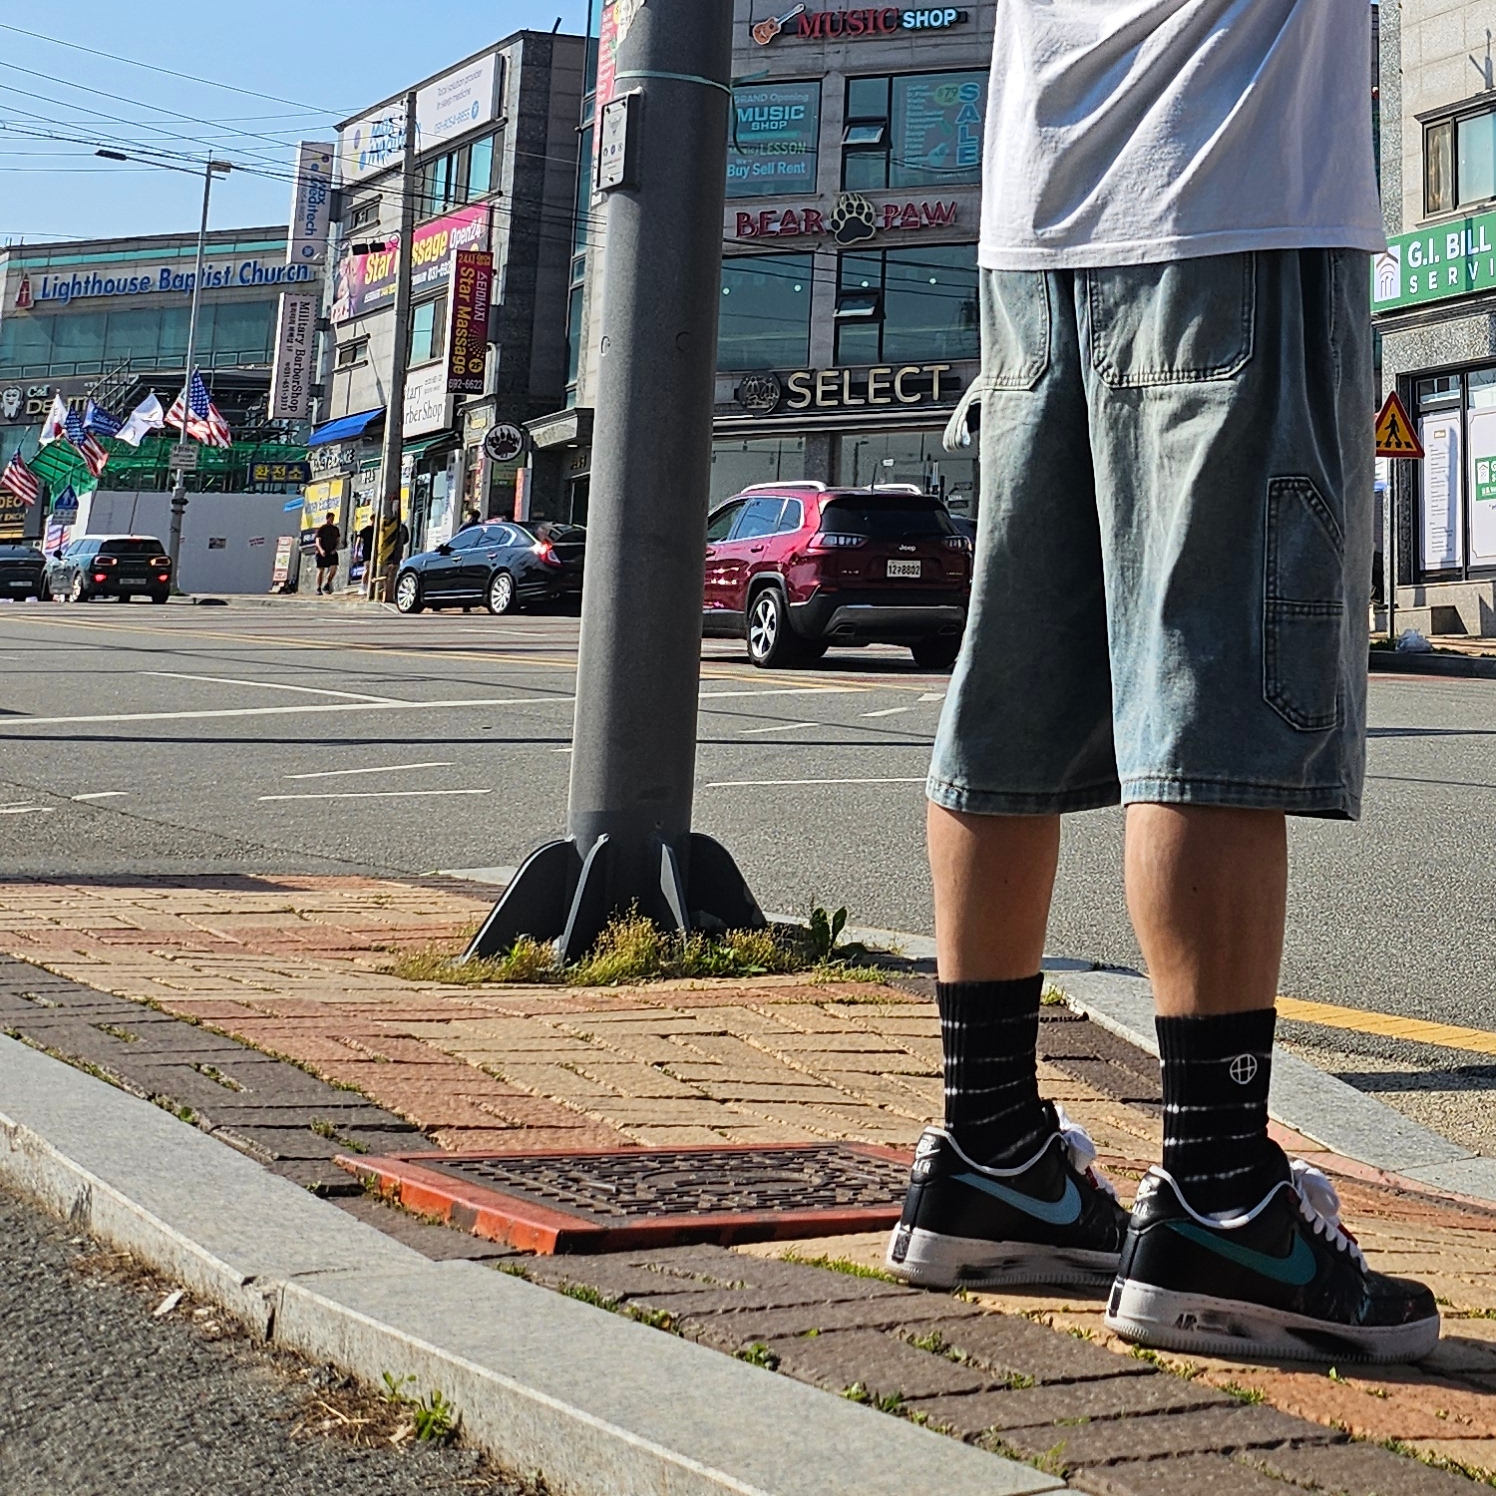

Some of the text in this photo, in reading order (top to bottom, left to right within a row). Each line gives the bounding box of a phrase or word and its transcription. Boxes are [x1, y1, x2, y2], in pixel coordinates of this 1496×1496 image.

[796, 7, 958, 38] MUSIC SHOP
[737, 105, 805, 122] MUSIC
[751, 120, 788, 131] SHOP
[955, 82, 981, 166] SALE
[760, 141, 806, 156] LESSON
[727, 161, 806, 179] Buy Sell Rent
[736, 201, 958, 238] BEAR PAW
[1408, 241, 1440, 269] G.I.
[1446, 225, 1492, 261] BILL
[41, 260, 309, 304] Lighthouse Baptist Church
[364, 251, 393, 285] Star
[295, 300, 311, 346] Military
[452, 266, 475, 376] Star Massage
[787, 364, 950, 409] SELECT
[422, 400, 443, 423] Shop
[252, 464, 305, 481] 환전소
[899, 544, 917, 552] Jeep
[1175, 1313, 1198, 1331] AIR
